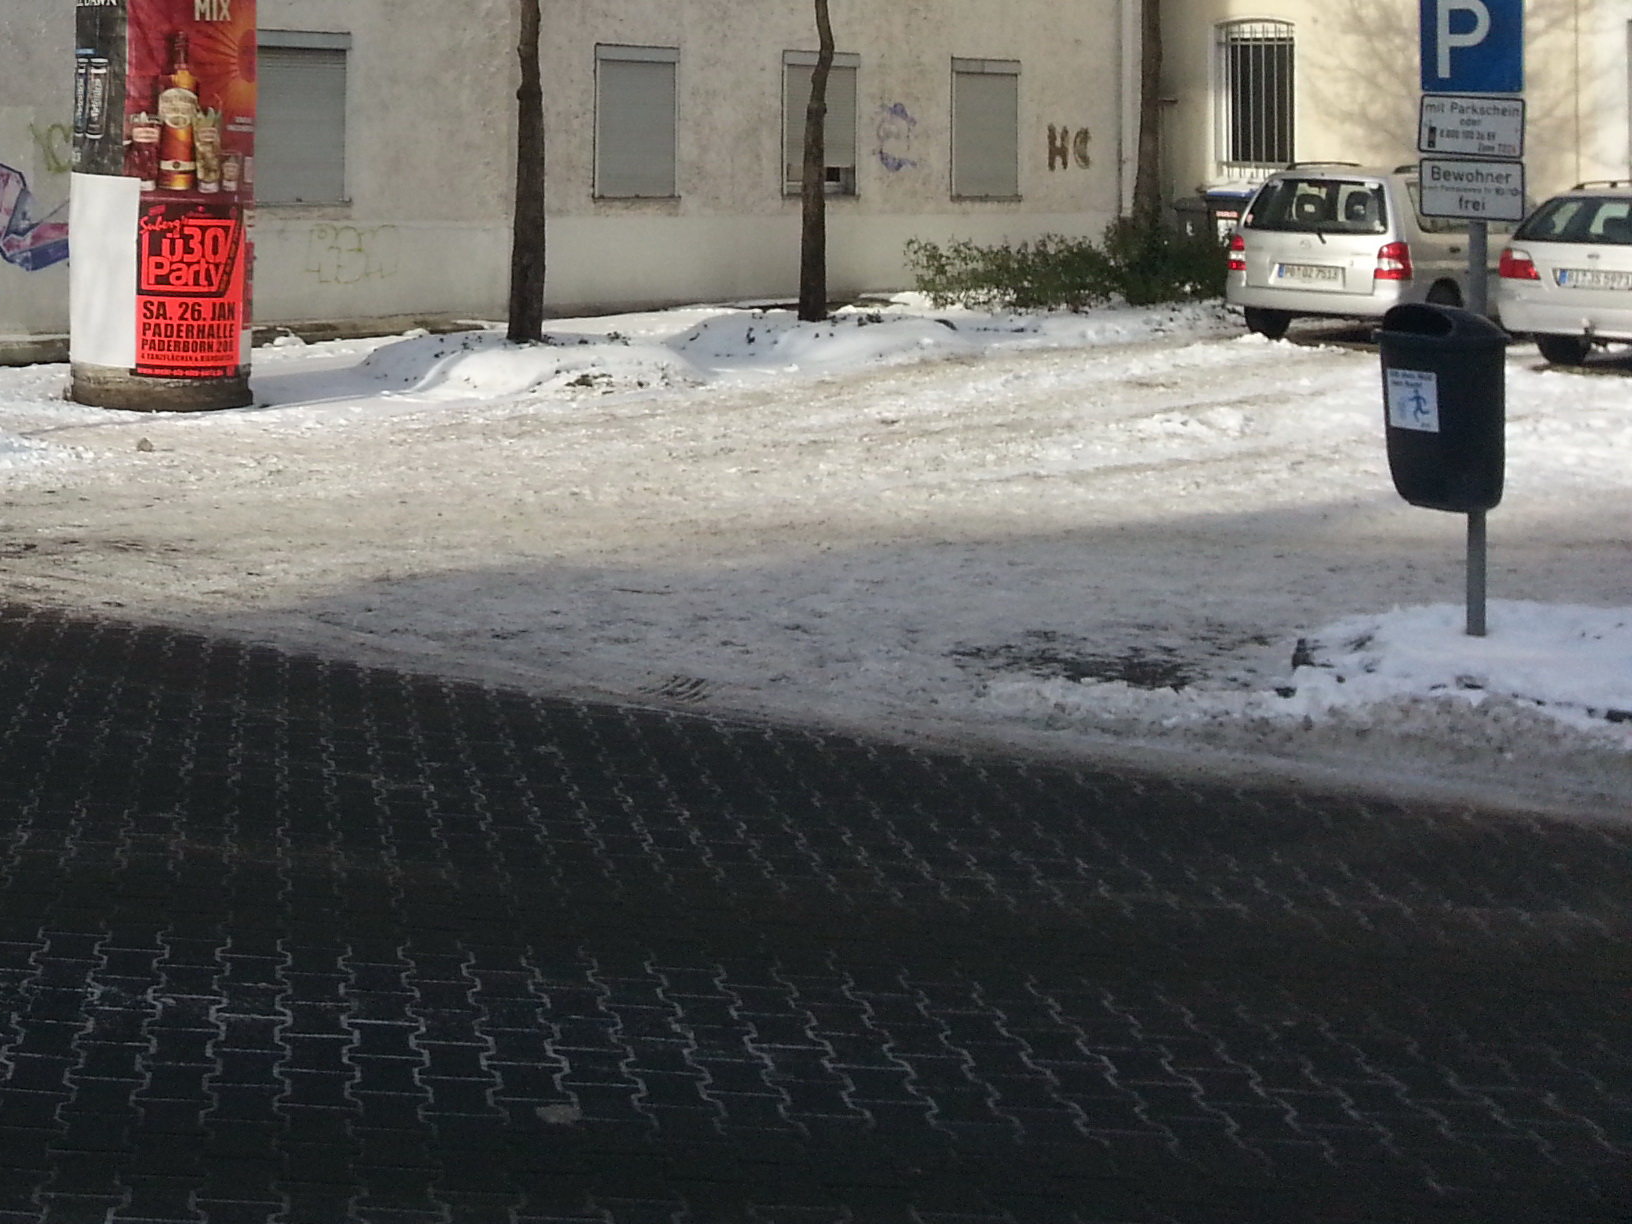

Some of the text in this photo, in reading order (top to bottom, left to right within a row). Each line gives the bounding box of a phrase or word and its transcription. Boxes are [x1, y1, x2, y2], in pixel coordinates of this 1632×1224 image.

[1425, 101, 1520, 117] mit Parkschein
[1431, 165, 1512, 185] Bewohner
[1459, 195, 1485, 211] frei
[148, 255, 225, 288] Party
[142, 300, 236, 322] SA. 26. JAN
[142, 321, 235, 339] PADERHALLE
[141, 338, 214, 353] PADERBORN
